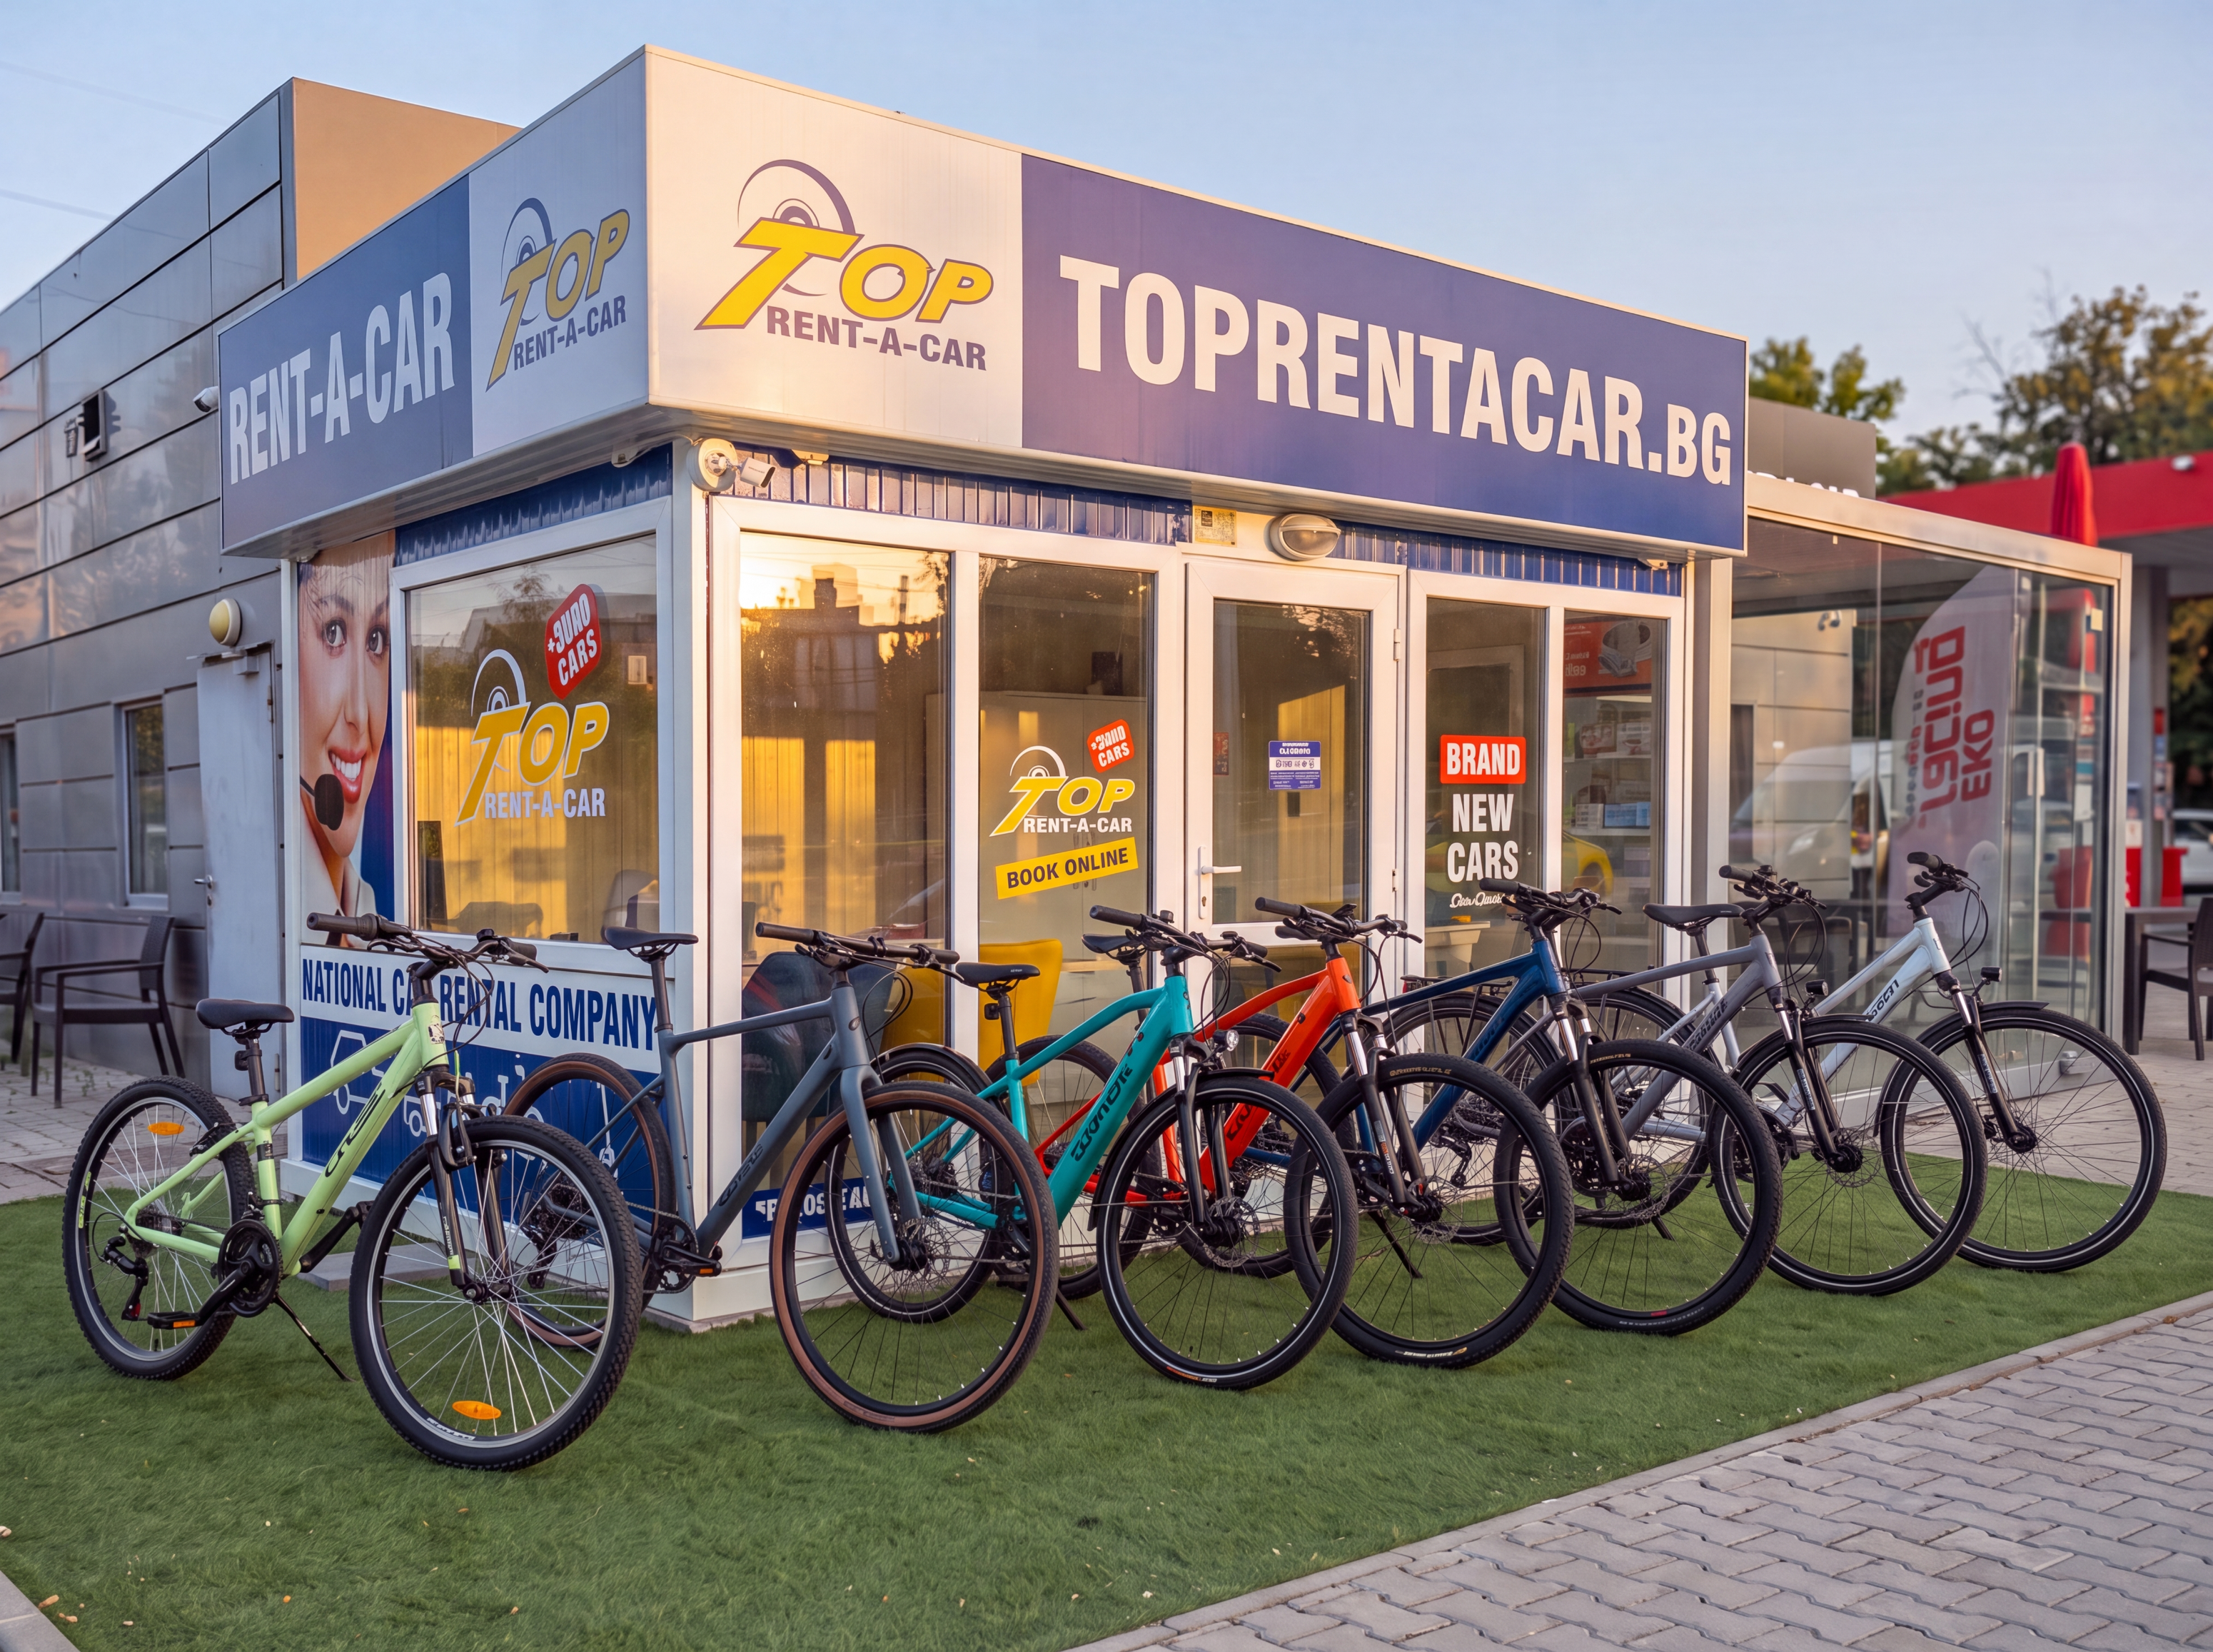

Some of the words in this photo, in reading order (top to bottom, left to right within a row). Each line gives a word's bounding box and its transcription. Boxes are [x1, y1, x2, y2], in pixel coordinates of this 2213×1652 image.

[486, 208, 630, 392] TOP
[694, 217, 994, 330] TOP
[514, 296, 626, 371] RENT-A-CAR
[767, 306, 986, 371] RENT-A-CAR
[230, 273, 455, 484] RENT-A-CAR
[1060, 255, 1730, 485] TOPRENTACAR.BG
[558, 629, 597, 685] CARS
[455, 702, 609, 827] TOP
[1098, 742, 1129, 767] CARS
[1447, 743, 1520, 775] BRAND
[485, 788, 605, 818] RENT-A-CAR
[989, 776, 1135, 837] TOP
[1024, 817, 1131, 832] RENT-A-CAR
[1453, 794, 1513, 832] NEW
[1007, 862, 1059, 889] BOOK
[1065, 847, 1128, 875] ONLINE
[1448, 840, 1518, 882] CARS
[302, 959, 386, 1012] NATIONAL
[440, 974, 522, 1032] RENTAL
[530, 984, 656, 1051] COMPANY
